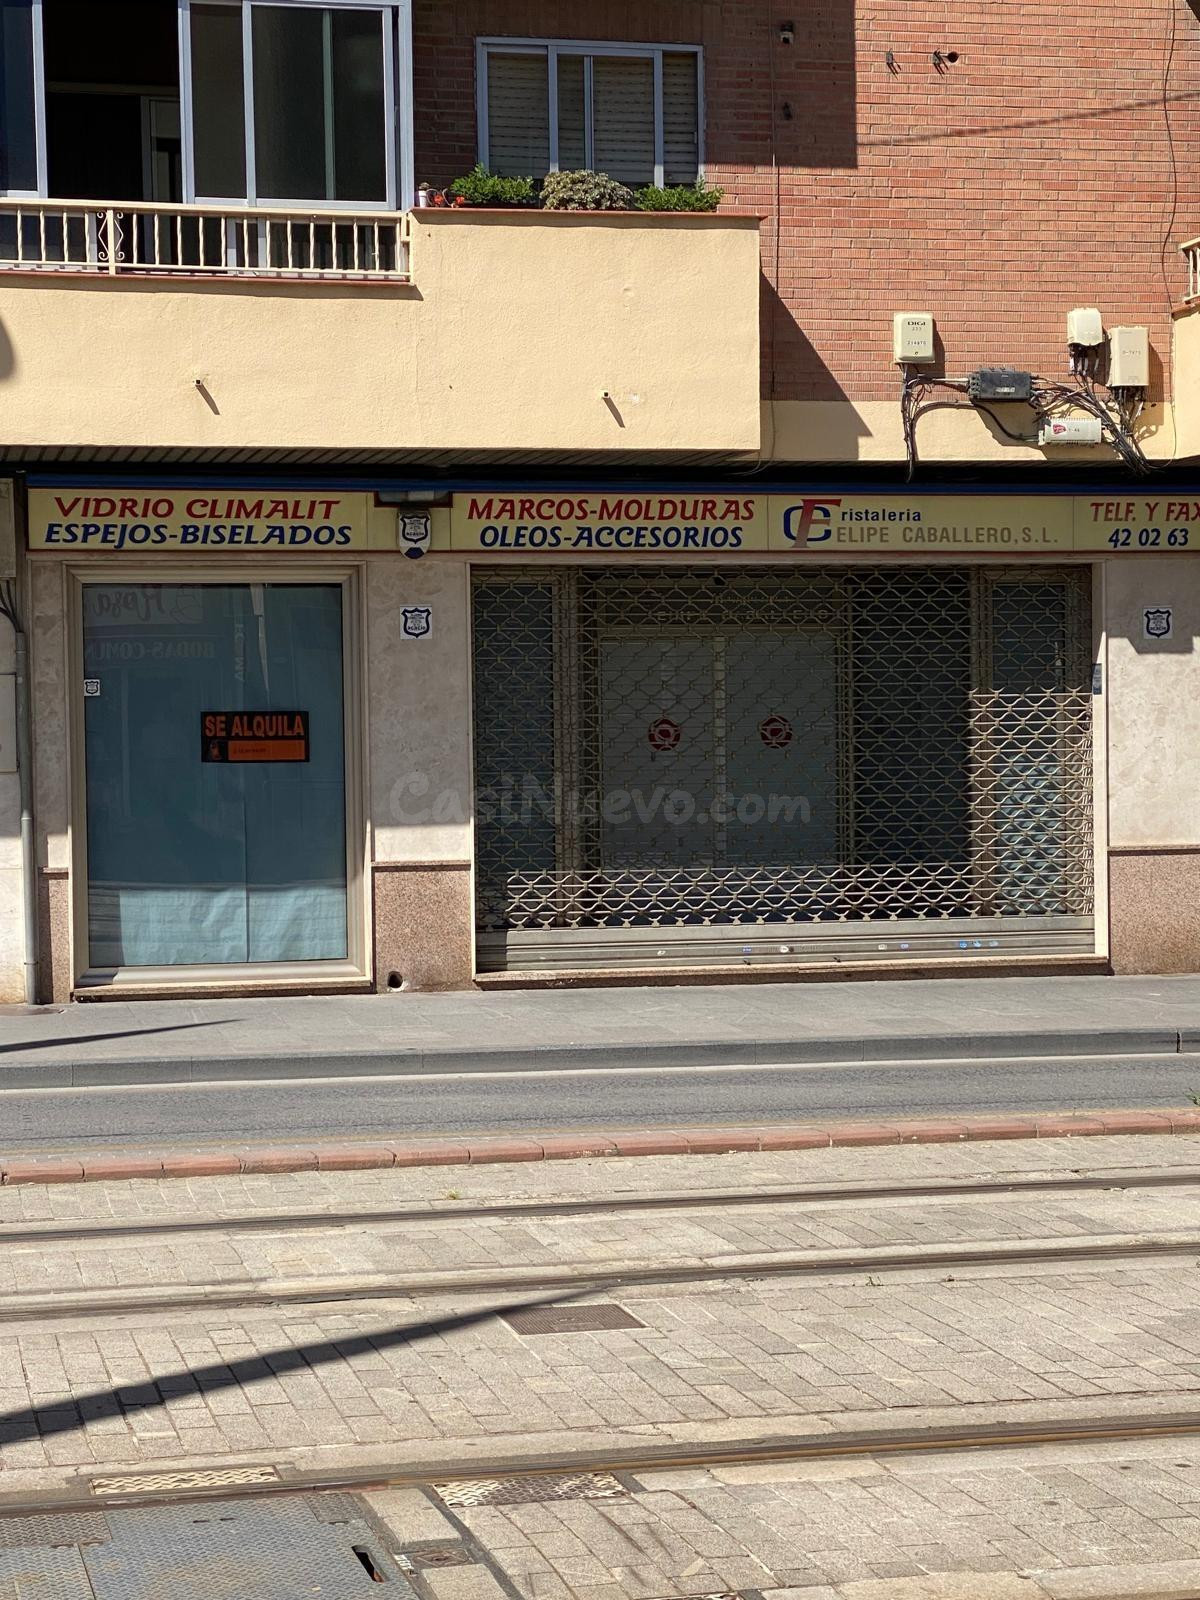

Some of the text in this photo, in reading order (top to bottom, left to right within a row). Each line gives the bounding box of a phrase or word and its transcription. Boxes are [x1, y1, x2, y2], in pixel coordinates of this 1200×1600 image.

[54, 497, 341, 520] VIDRIO CLIMALIT
[467, 498, 755, 521] MARCOS-MOLDURAS
[1090, 502, 1137, 522] TELF.
[1145, 502, 1160, 522] Y
[45, 522, 352, 549] ESPEJOS-BISELADOS
[479, 525, 744, 549] OLEOS-ACCESORIOS
[1107, 528, 1189, 548] 42 02 63
[205, 715, 305, 738] SE ALQUILA
